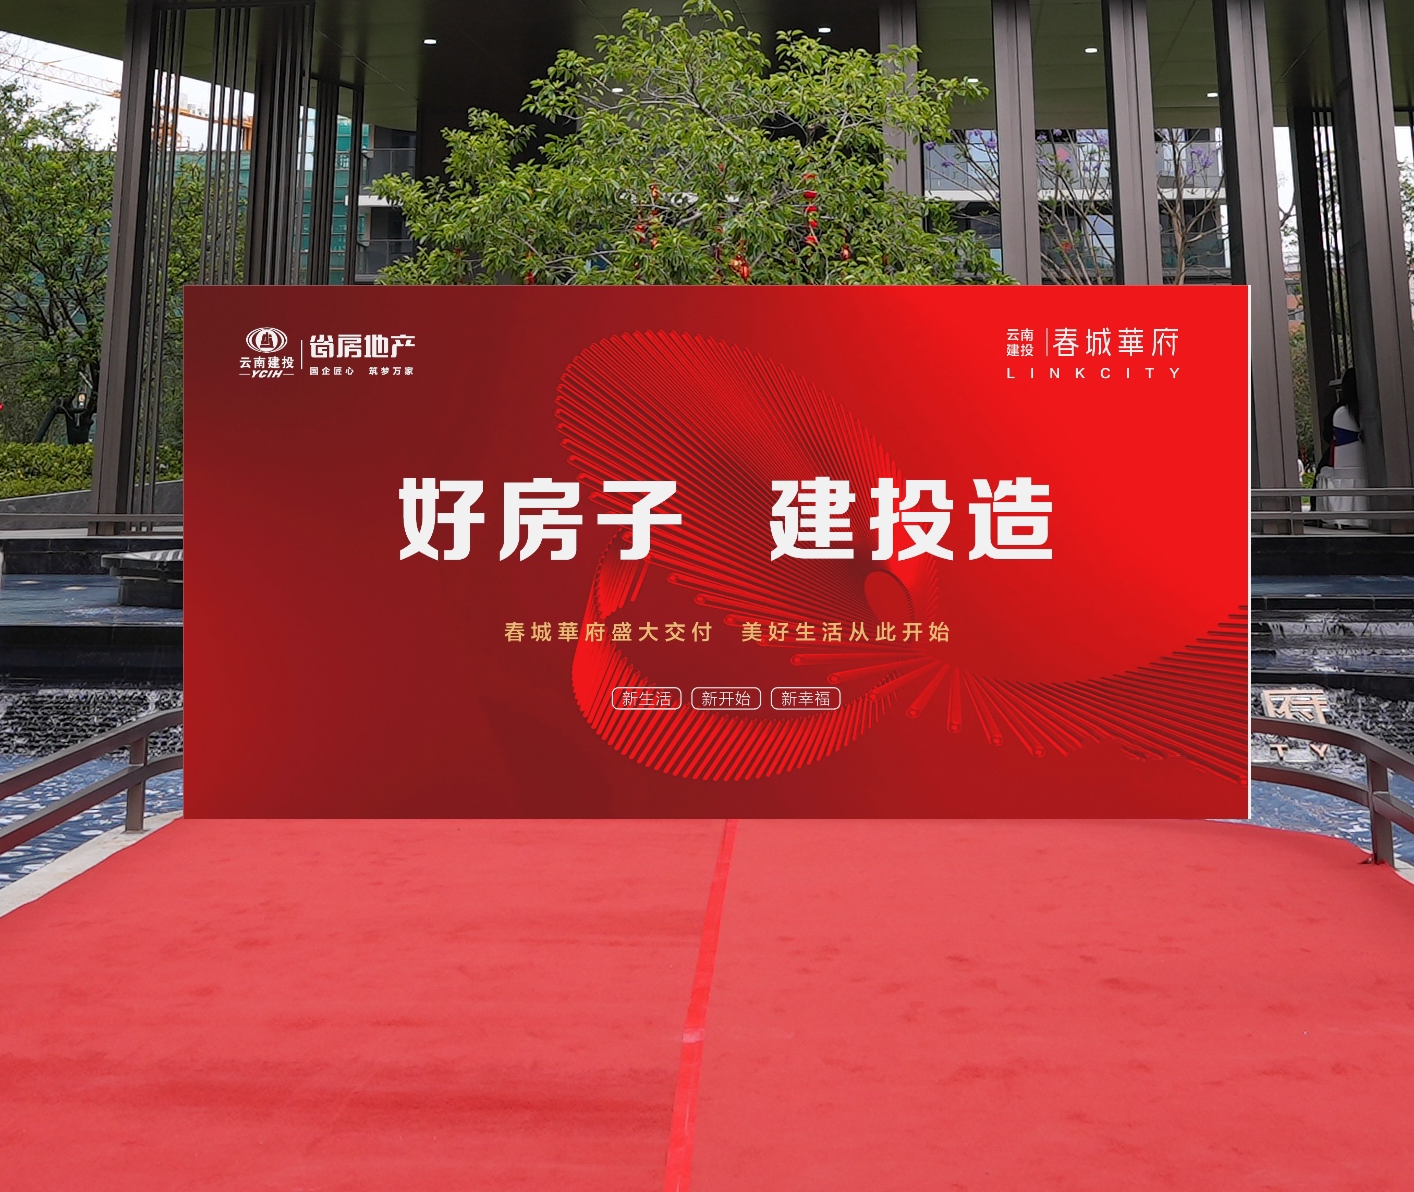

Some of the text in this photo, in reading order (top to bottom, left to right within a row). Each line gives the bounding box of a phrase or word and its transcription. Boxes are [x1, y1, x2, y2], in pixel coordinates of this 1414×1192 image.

[1006, 328, 1034, 342] 云南
[1052, 327, 1179, 357] 春城華府
[1006, 343, 1034, 357] 建投
[239, 356, 295, 369] 云南建投
[251, 369, 284, 379] YCIH
[309, 366, 414, 376] 国企匠心 筑梦万家
[1006, 367, 1180, 379] LINKCITY
[398, 476, 1053, 562] 好房子 建投造
[504, 621, 950, 643] 春城華府盛大交付 美好生活从此开始
[622, 690, 672, 707] 新生活
[701, 690, 751, 707] 新开始
[781, 690, 831, 707] 新幸福
